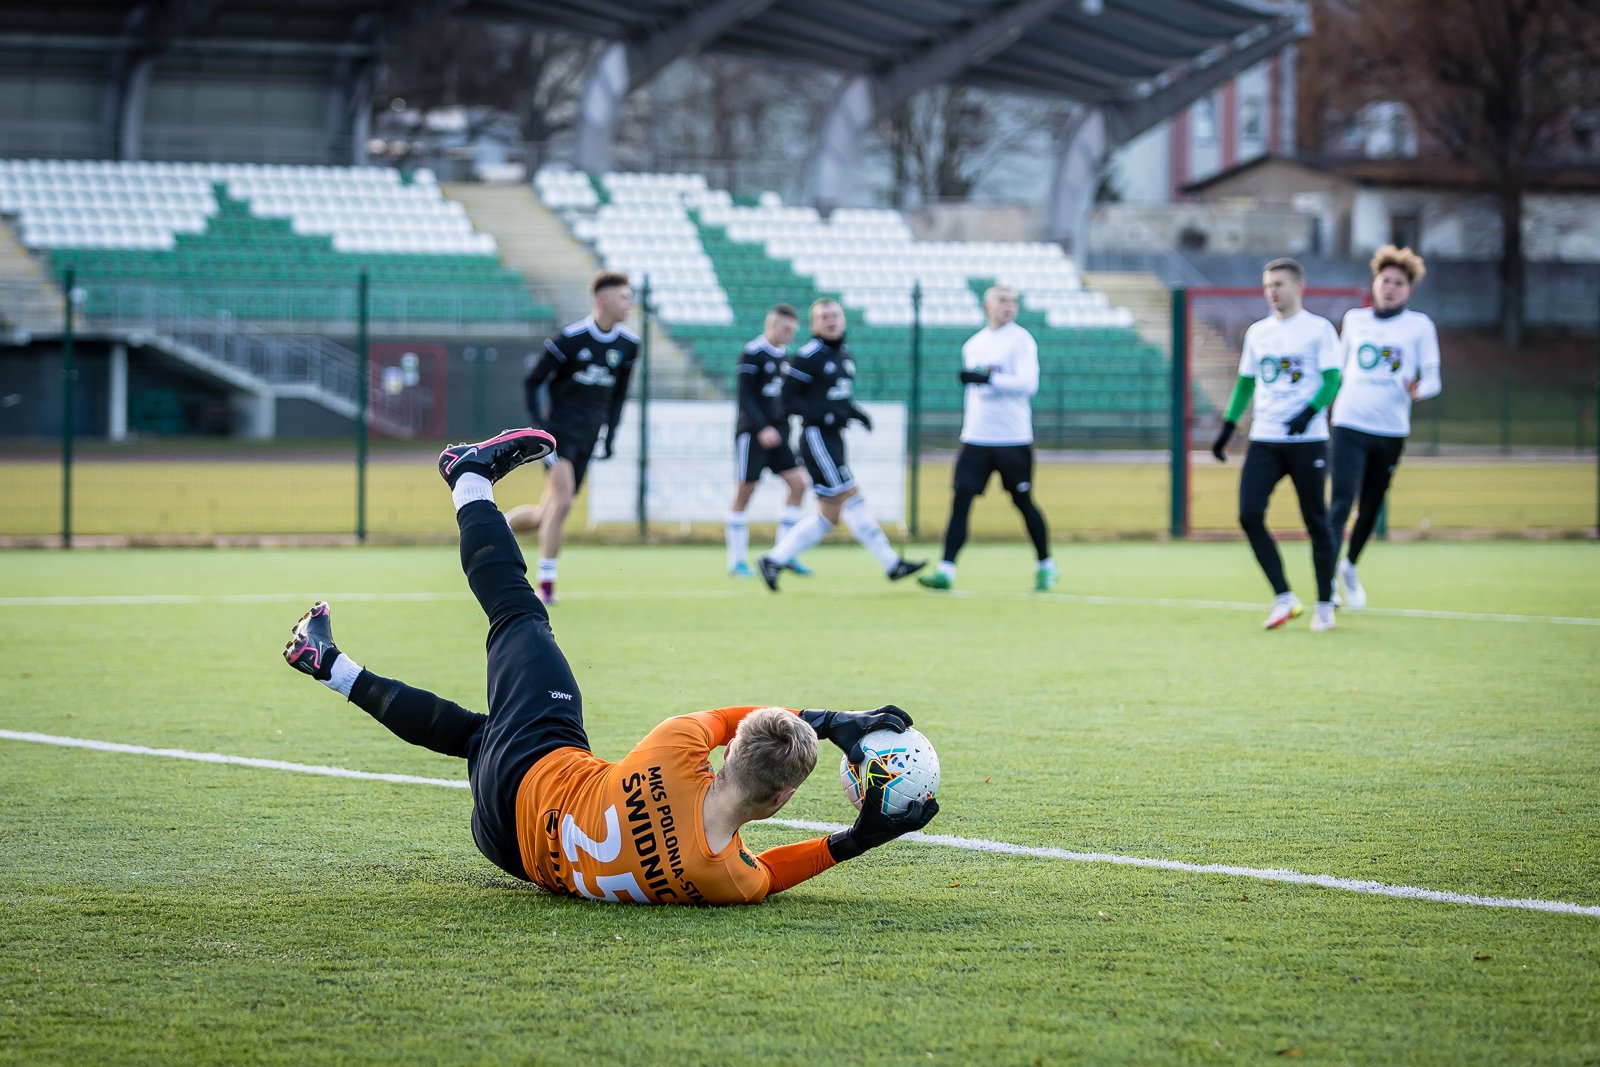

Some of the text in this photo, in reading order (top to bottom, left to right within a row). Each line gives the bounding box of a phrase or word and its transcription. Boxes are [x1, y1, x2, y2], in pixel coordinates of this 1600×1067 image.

[547, 690, 573, 701] JAKO
[647, 766, 667, 802] MKS
[561, 803, 651, 904] 25
